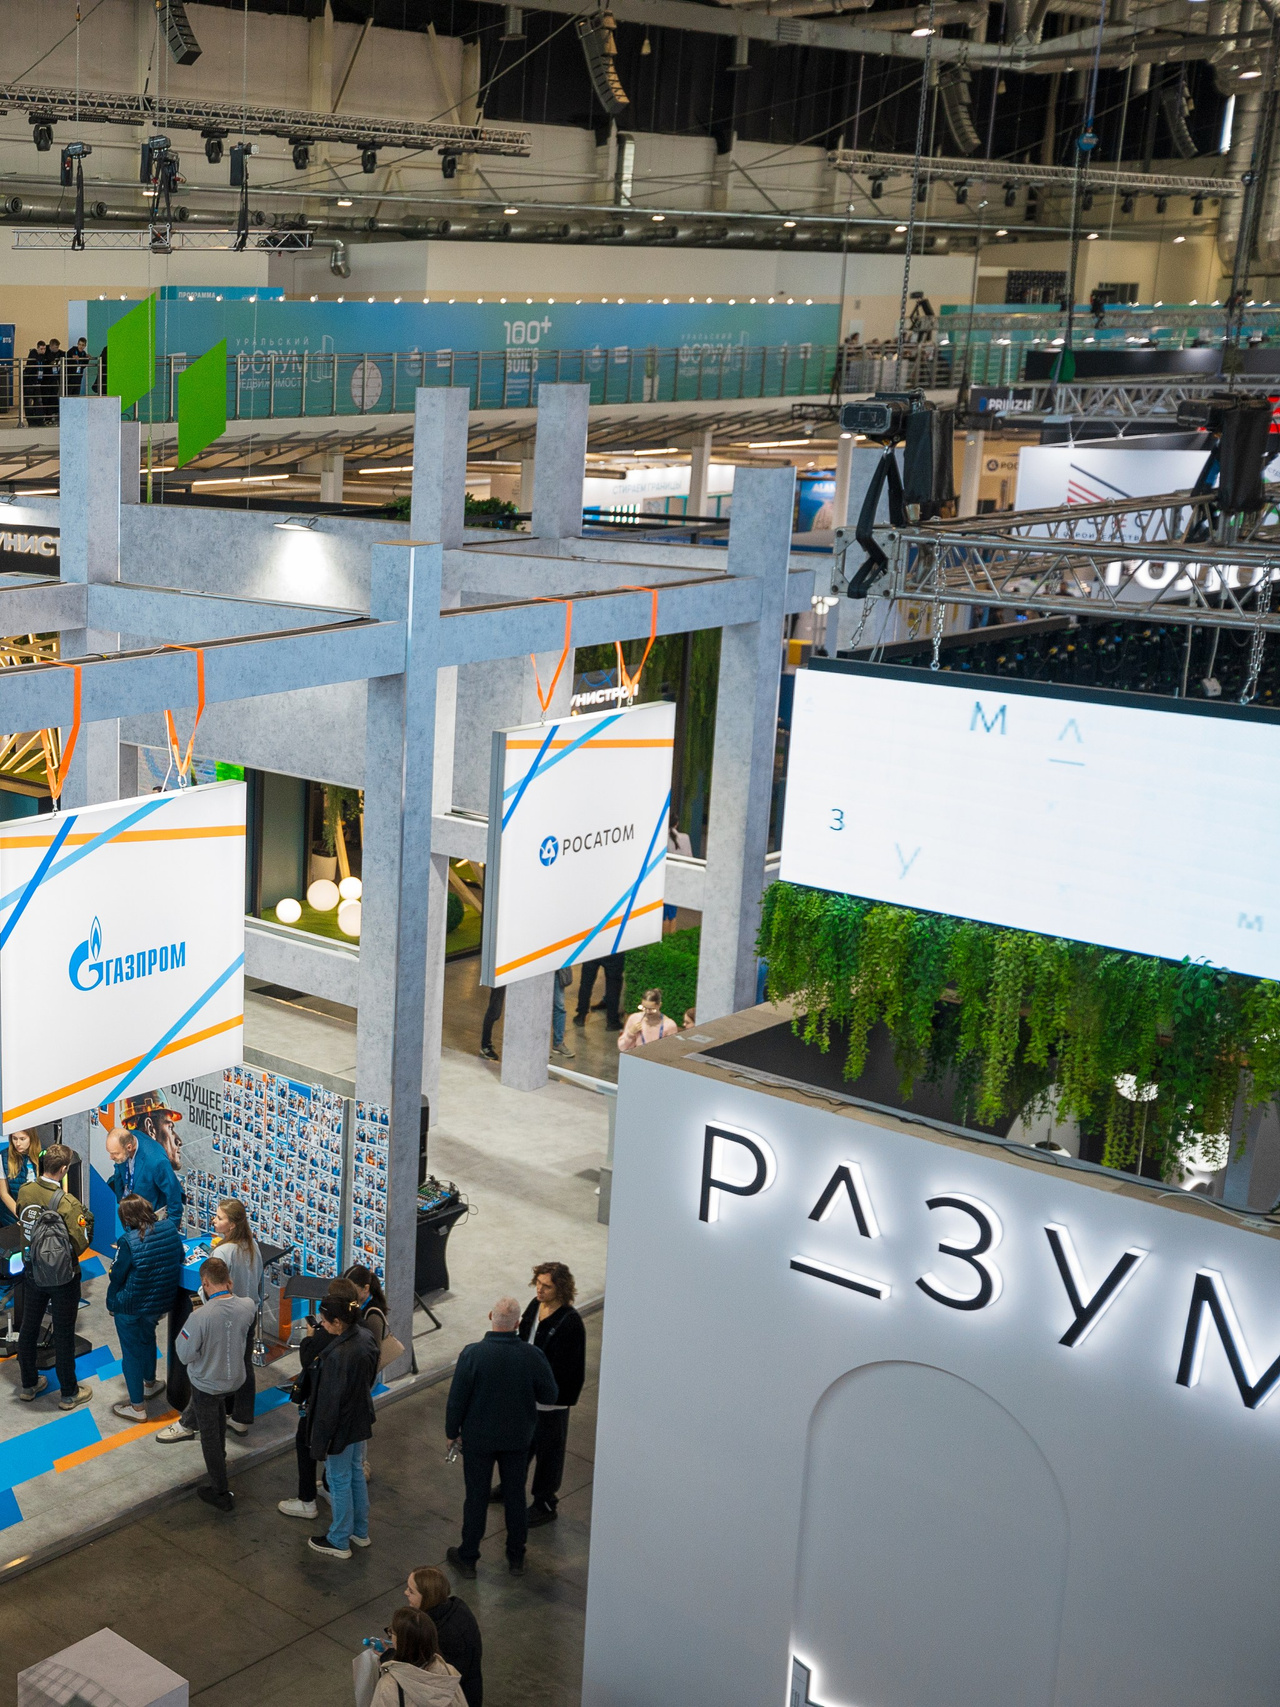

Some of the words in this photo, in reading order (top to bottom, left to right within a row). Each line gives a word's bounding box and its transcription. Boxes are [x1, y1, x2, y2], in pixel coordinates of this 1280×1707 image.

[236, 336, 309, 346] УРАЛЬСКИЙ
[236, 350, 309, 374] ФОРУМ
[613, 484, 646, 495] СТИРАЕМ
[648, 480, 682, 492] ГРАНИЦЫ
[562, 823, 635, 856] РОСАТОМ
[105, 941, 186, 986] ГАЗПРОМ
[171, 1081, 221, 1111] БУДУЩЕЕ
[188, 1104, 232, 1137] ВМЕСТЕ
